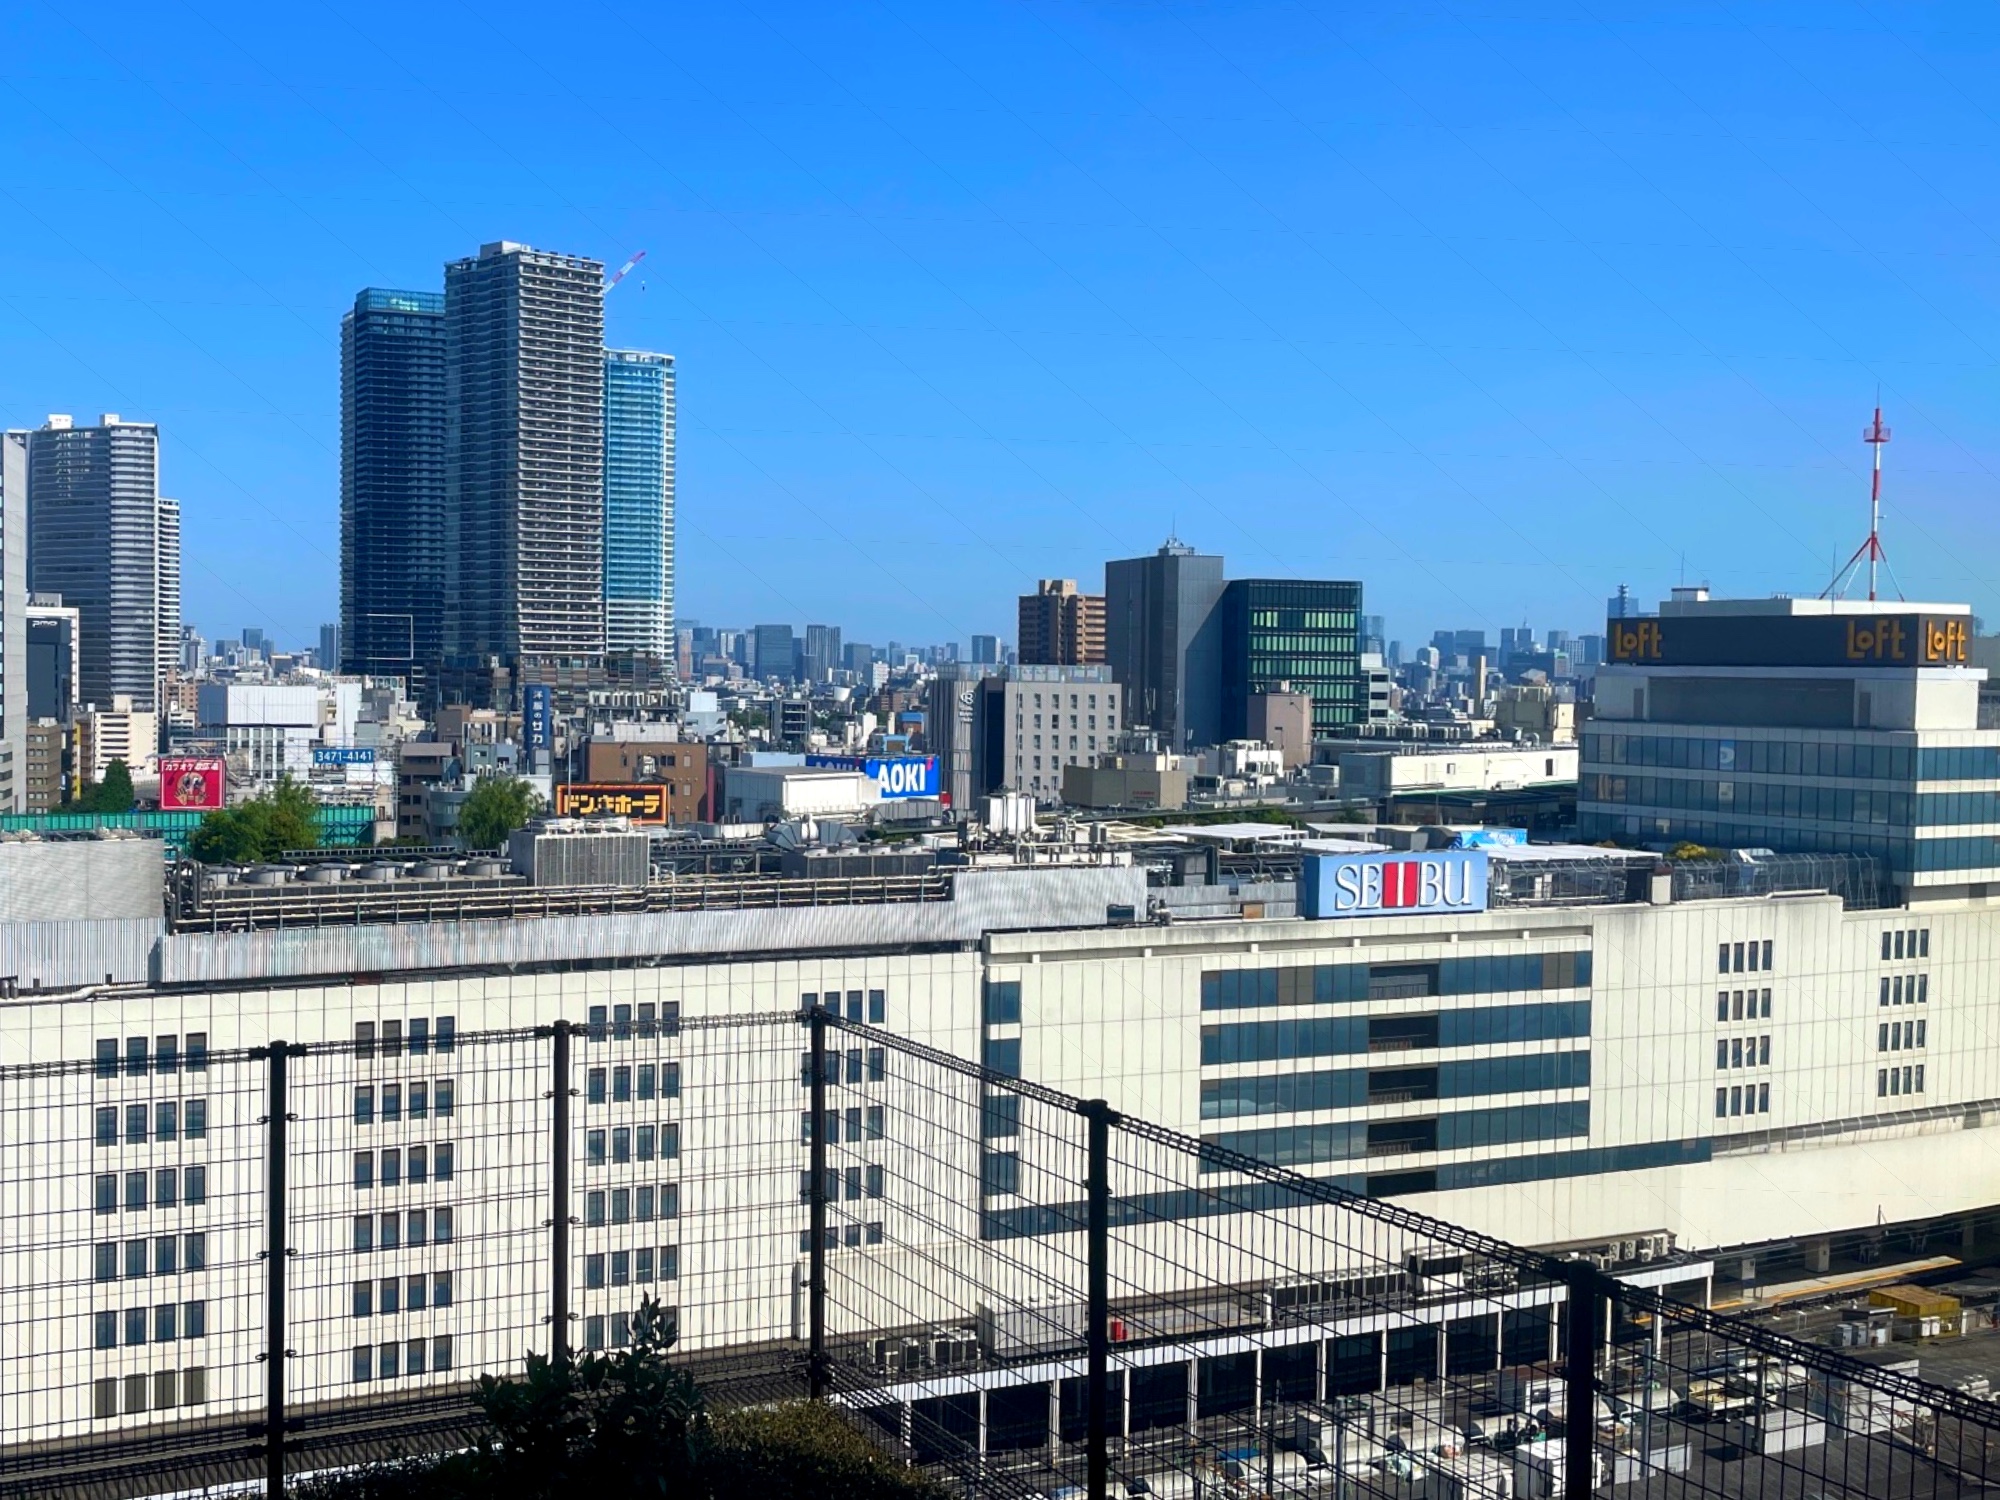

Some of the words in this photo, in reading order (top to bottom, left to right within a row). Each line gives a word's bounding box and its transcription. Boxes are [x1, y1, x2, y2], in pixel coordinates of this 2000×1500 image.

[317, 751, 372, 762] 3471-4141
[878, 763, 926, 793] AOKI
[1335, 860, 1472, 910] SEIBU
